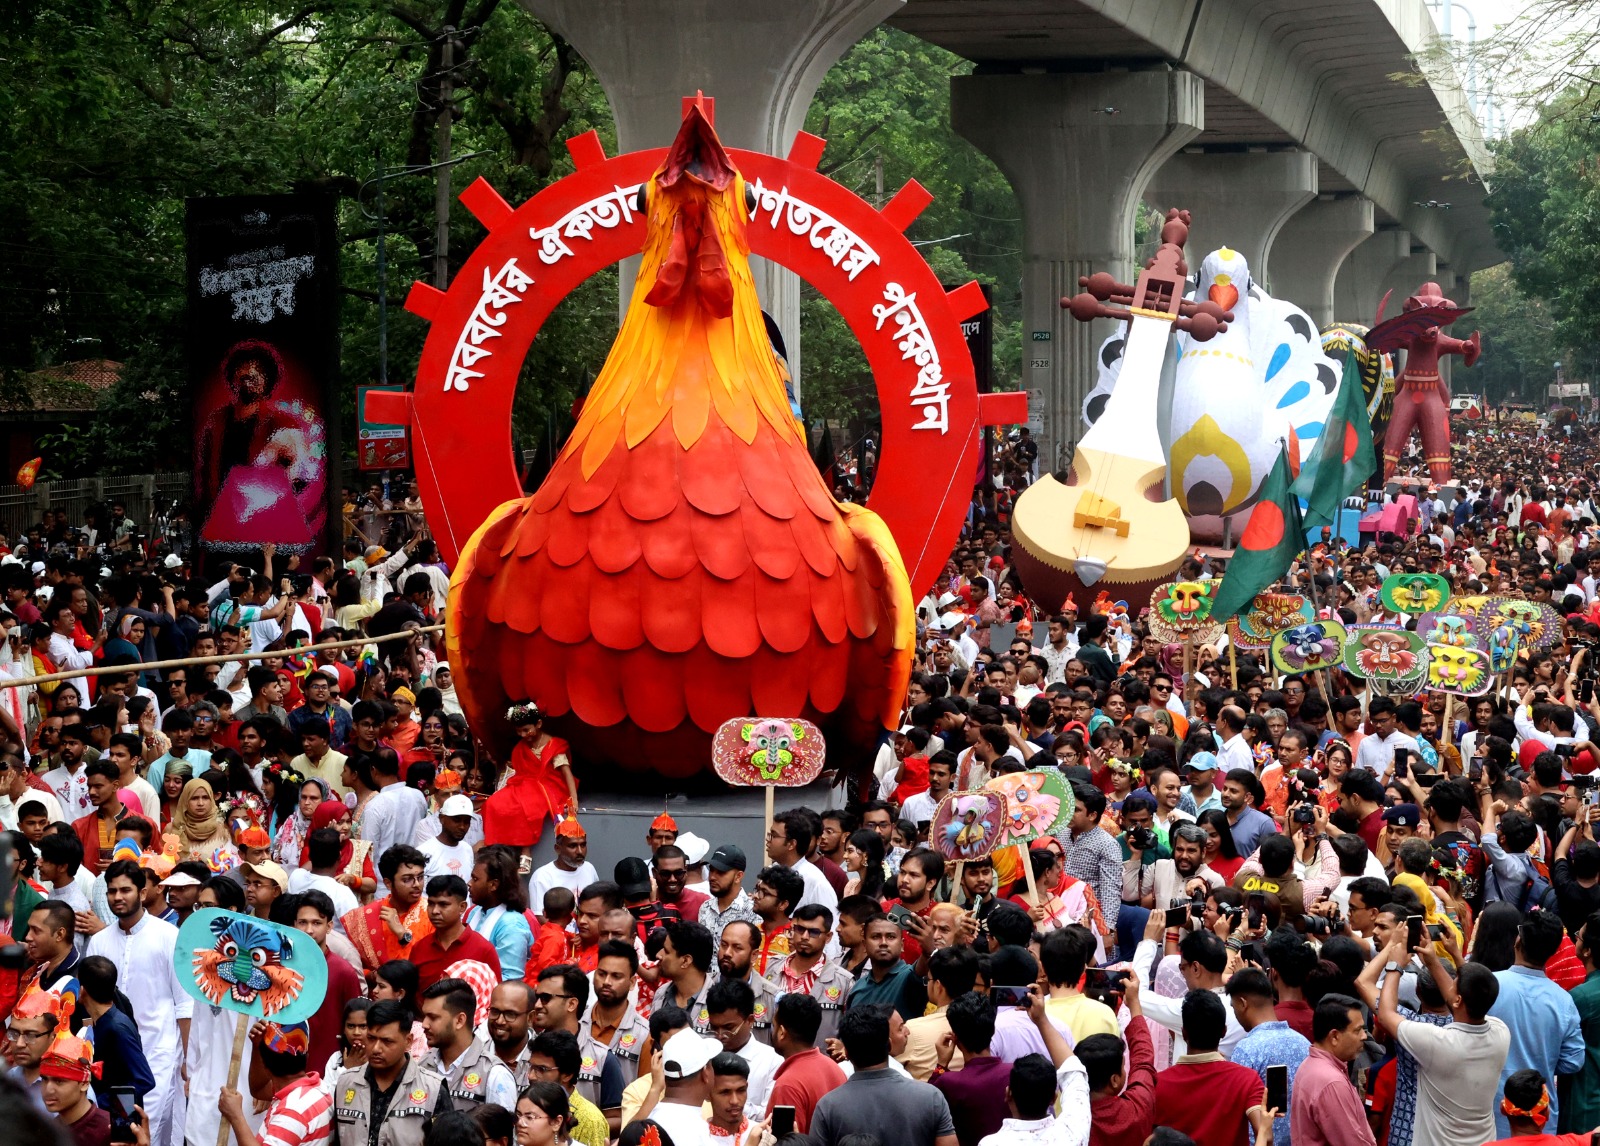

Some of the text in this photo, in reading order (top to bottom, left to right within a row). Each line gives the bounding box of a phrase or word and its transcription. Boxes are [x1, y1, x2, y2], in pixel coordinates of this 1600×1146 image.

[443, 257, 535, 392] নববর্ষের
[1030, 360, 1049, 368] P528
[1242, 877, 1280, 894] DMP
